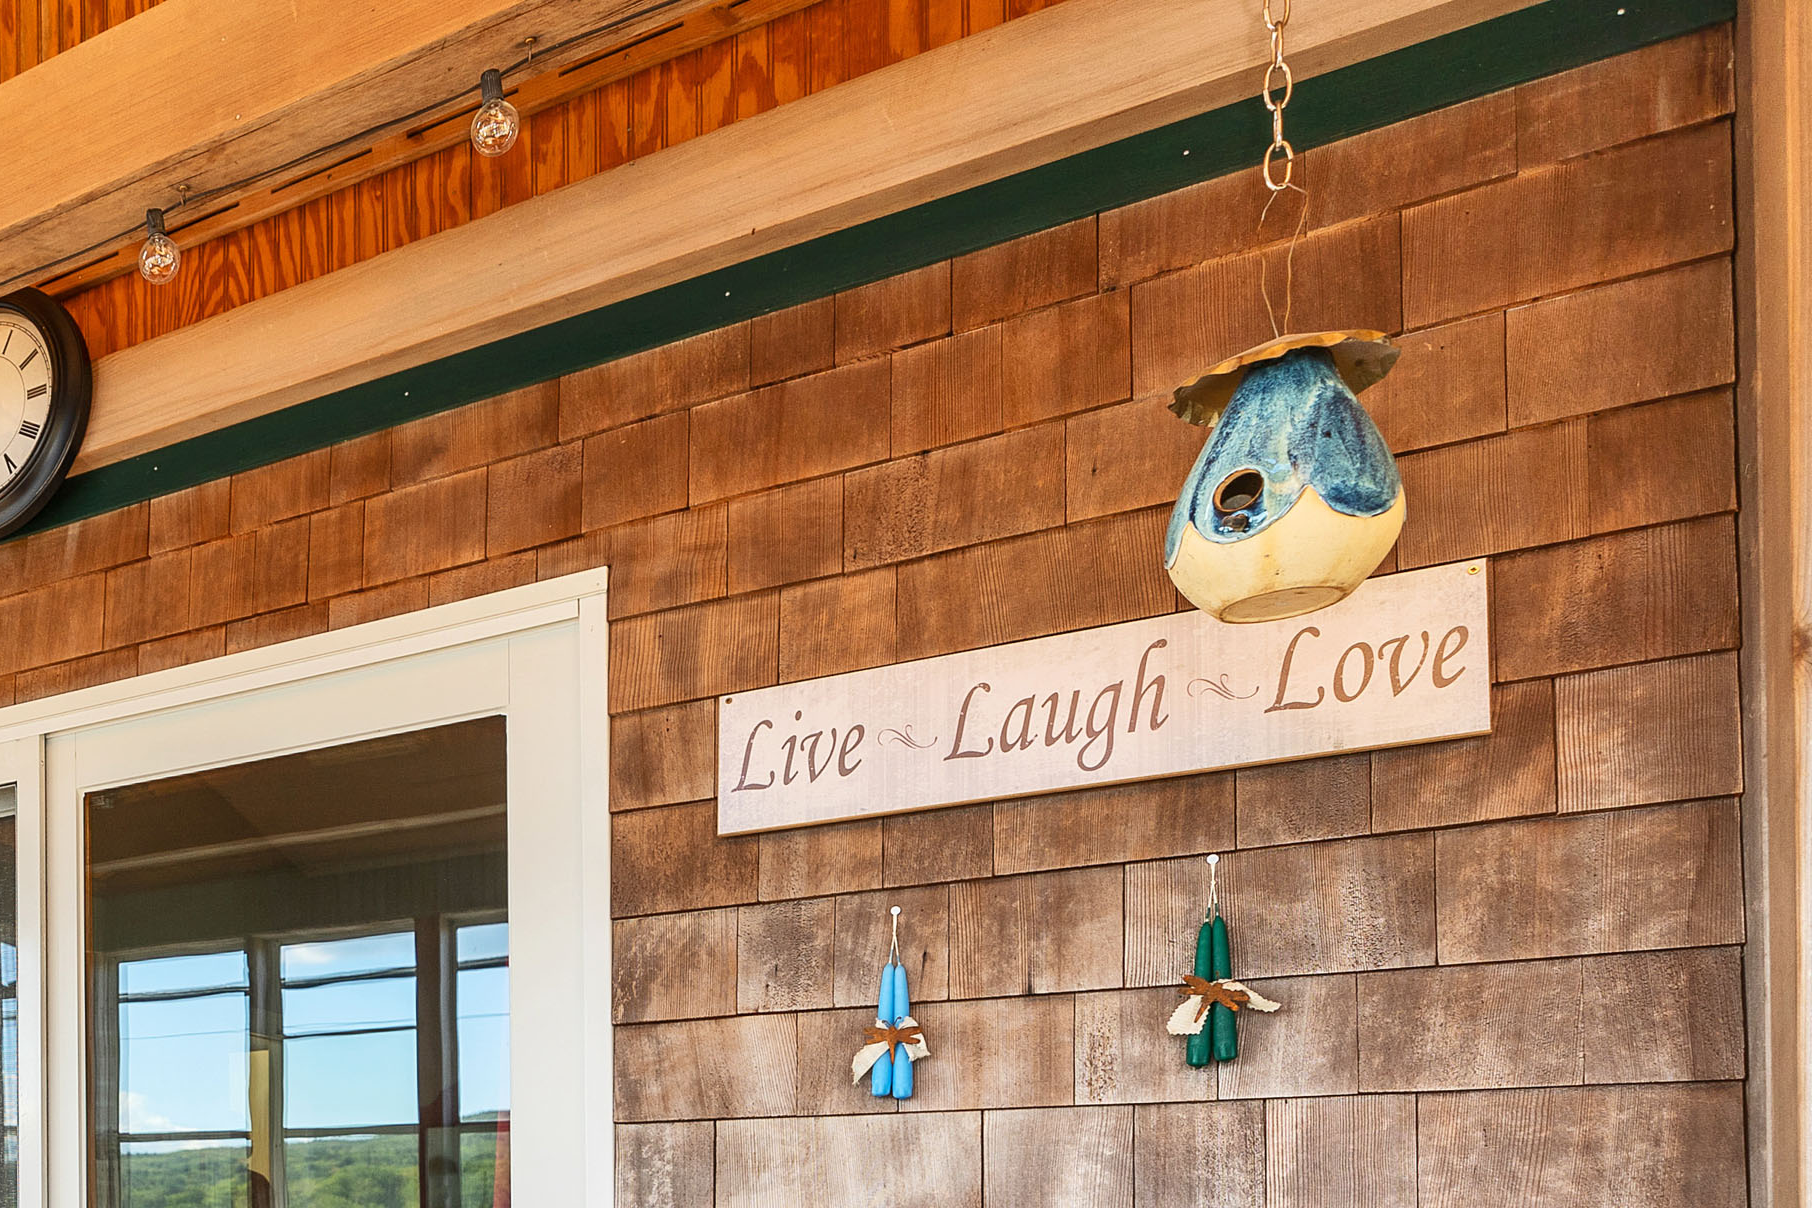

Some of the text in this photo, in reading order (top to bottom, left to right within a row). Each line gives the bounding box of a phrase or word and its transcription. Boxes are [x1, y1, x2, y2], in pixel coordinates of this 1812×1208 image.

[2, 329, 13, 354] I
[19, 348, 38, 371] II
[27, 383, 47, 400] III
[3, 453, 17, 474] V
[731, 625, 1469, 793] Live Laugh Love
